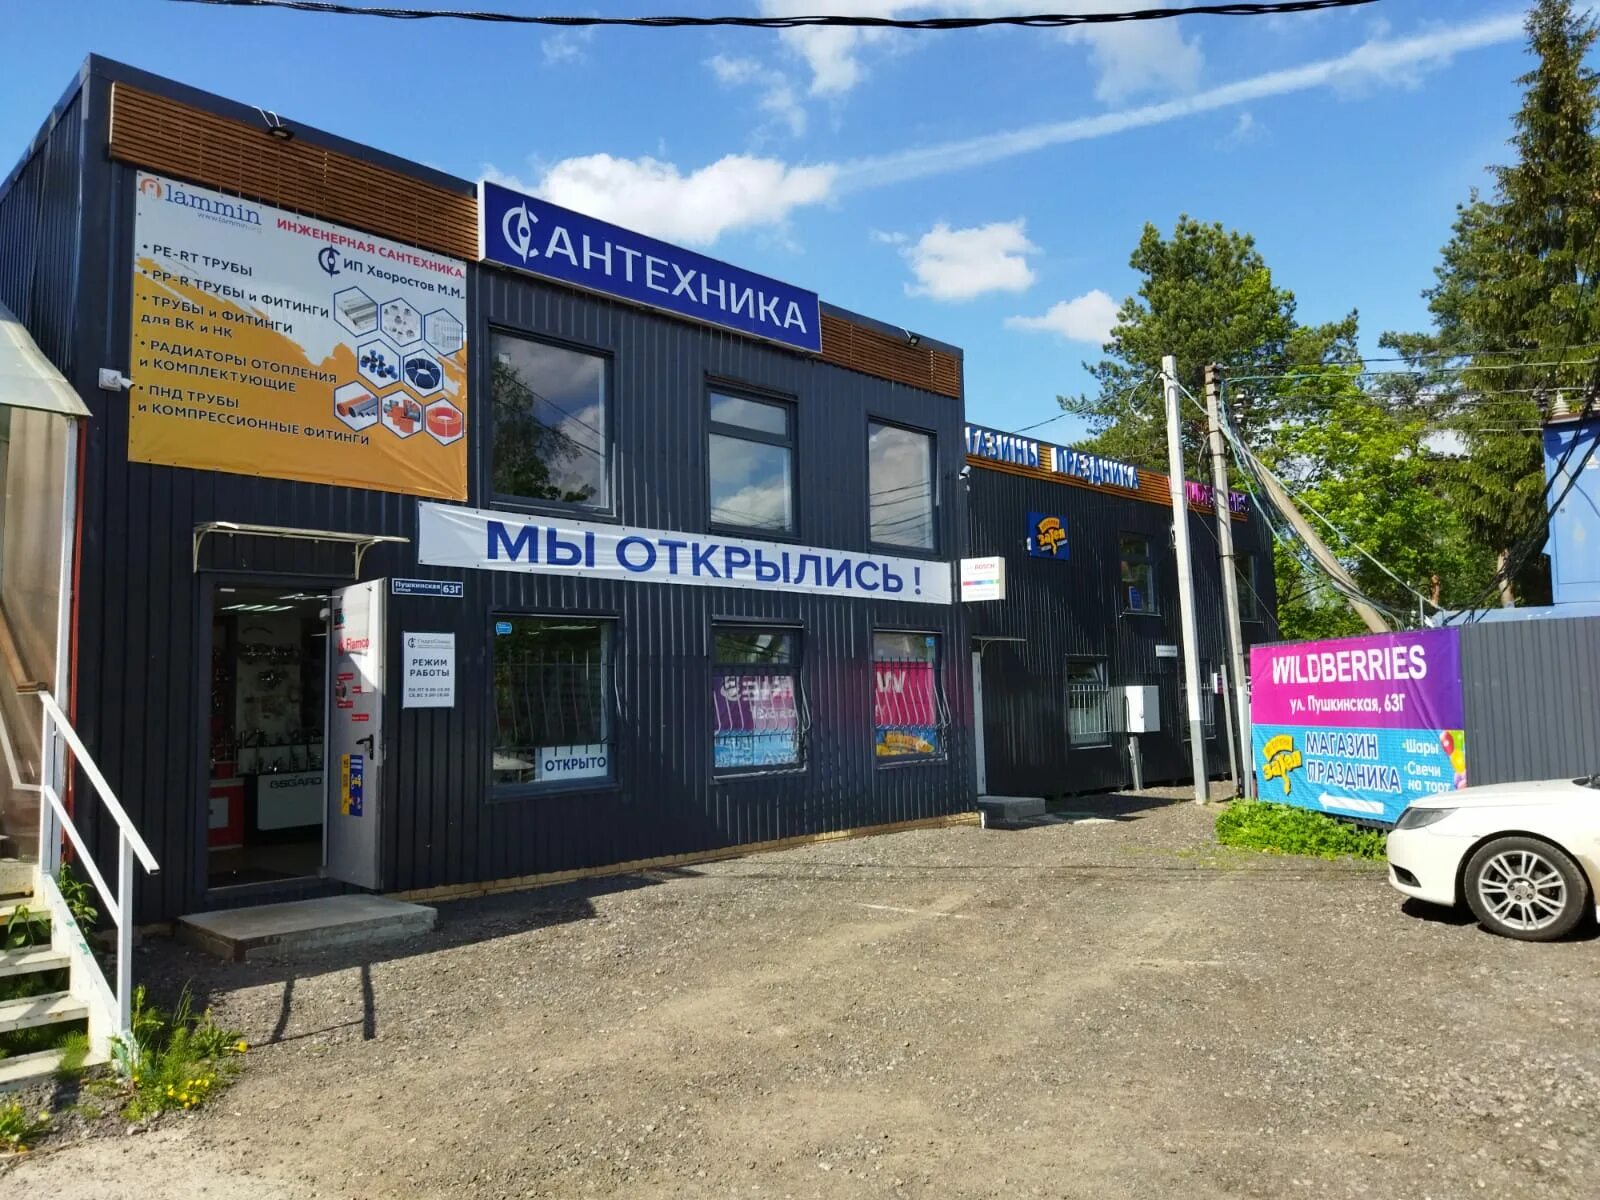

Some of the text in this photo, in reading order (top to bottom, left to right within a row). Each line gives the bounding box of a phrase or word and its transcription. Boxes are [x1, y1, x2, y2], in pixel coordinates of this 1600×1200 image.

[165, 184, 262, 225] lammin
[153, 244, 252, 276] PE-RT ТРУБЫ
[277, 217, 463, 278] ИНЖЕНЕРНАЯ САНТЕХНИКА
[343, 258, 363, 273] ИП
[367, 263, 435, 292] Хворостов
[502, 200, 807, 334] САНТЕХНИКА
[152, 270, 329, 318] PP-R ТРУБЫ и ФИТИНГИ
[141, 314, 233, 338] для ВК и НК
[152, 296, 293, 334] ТРУБЫ и ФИТИНГИ
[140, 358, 296, 393] и КОМПЛЕКТУЮЩИЕ
[150, 340, 337, 383] РАДИАТОРЫ ОТОПЛЕНИЯ
[149, 385, 240, 409] ПНД ТРУБЫ
[138, 403, 370, 446] и КОМПРЕССИОННЫЕ ФИТИНГИ
[1050, 447, 1139, 490] ПРАЗДНИКА
[487, 520, 595, 568] МЫ
[395, 581, 461, 594] Пушкинская 63Г
[410, 669, 449, 677] РАБОТЫ
[412, 659, 447, 667] РЕЖИМ
[1272, 645, 1427, 685] WILDBERRIES
[1289, 694, 1405, 715] ул. Пушкинская, 63Г
[1305, 731, 1378, 760] МАГАЗИН
[1406, 738, 1439, 757] Шары
[544, 755, 607, 772] ОТКРЫТО
[1306, 761, 1402, 793] ПРАЗДНИКА
[1407, 760, 1441, 777] Свечи
[1408, 779, 1422, 791] на
